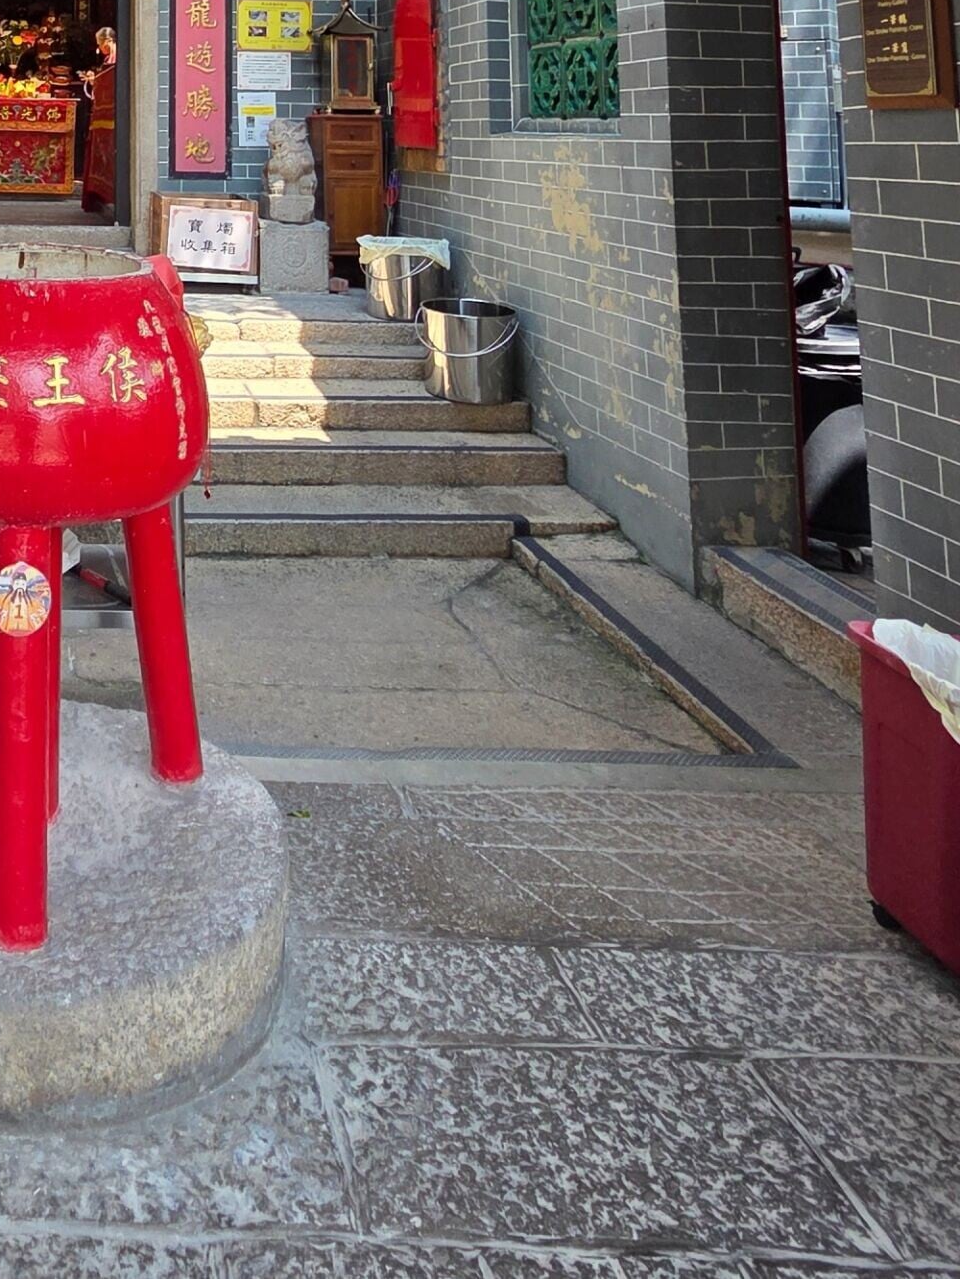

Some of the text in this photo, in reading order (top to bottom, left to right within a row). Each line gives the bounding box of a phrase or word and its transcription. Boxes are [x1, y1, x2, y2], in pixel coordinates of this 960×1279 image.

[181, 238, 236, 255] 收集箱
[14, 604, 23, 619] 1
